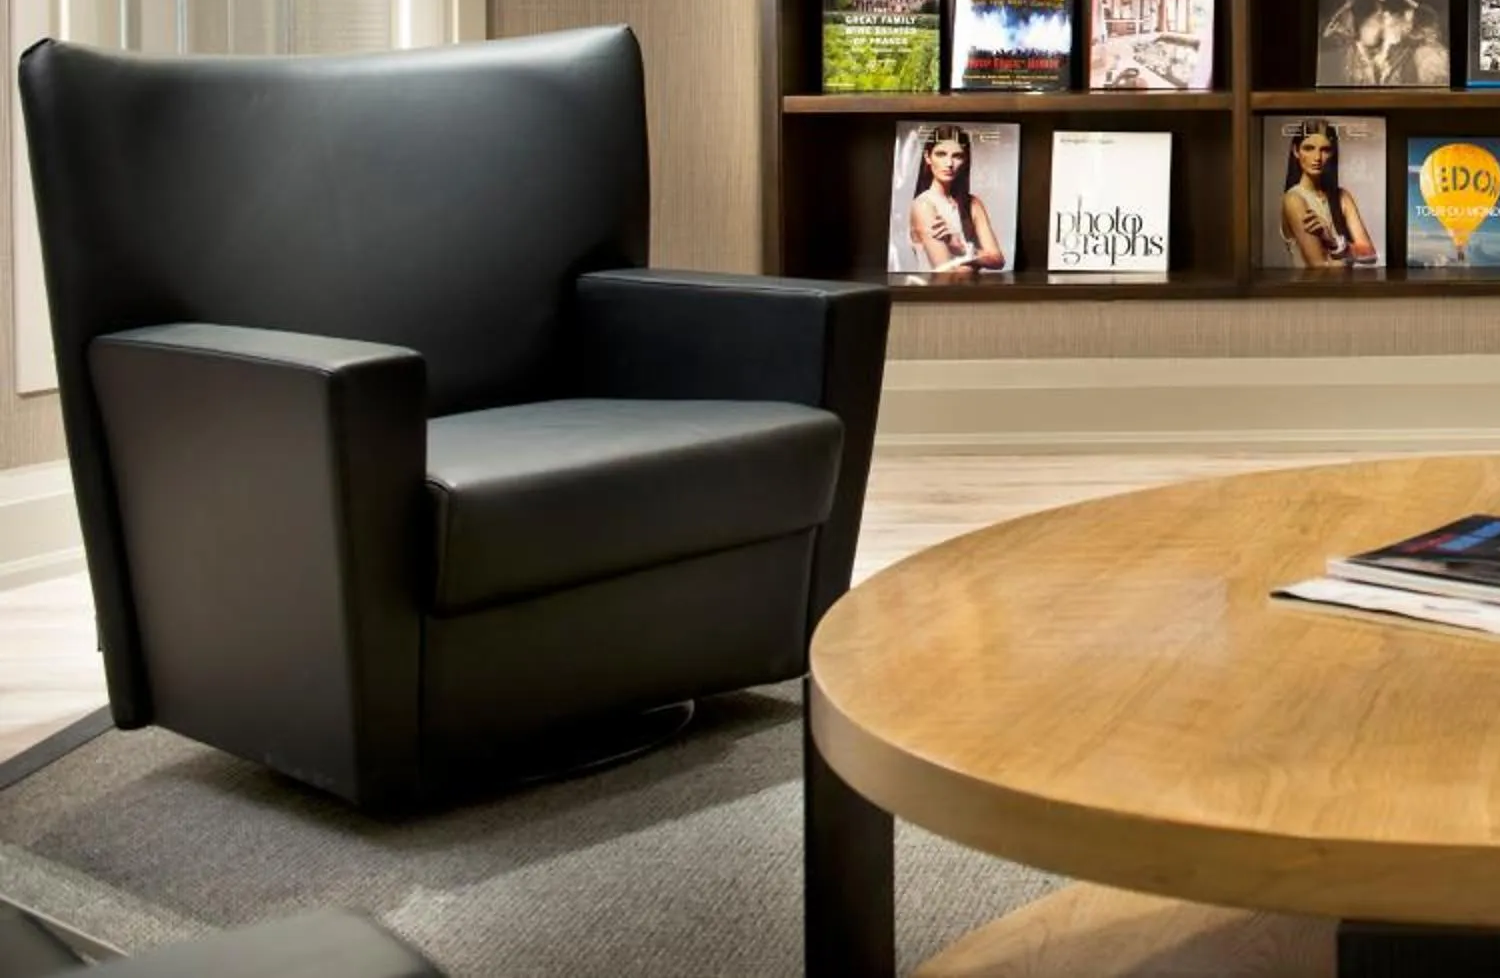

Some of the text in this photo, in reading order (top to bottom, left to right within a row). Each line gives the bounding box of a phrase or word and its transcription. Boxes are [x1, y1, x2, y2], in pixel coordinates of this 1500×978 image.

[845, 15, 916, 24] GREAT FAMILY
[1055, 194, 1143, 243] photo
[1061, 217, 1164, 266] graphs
